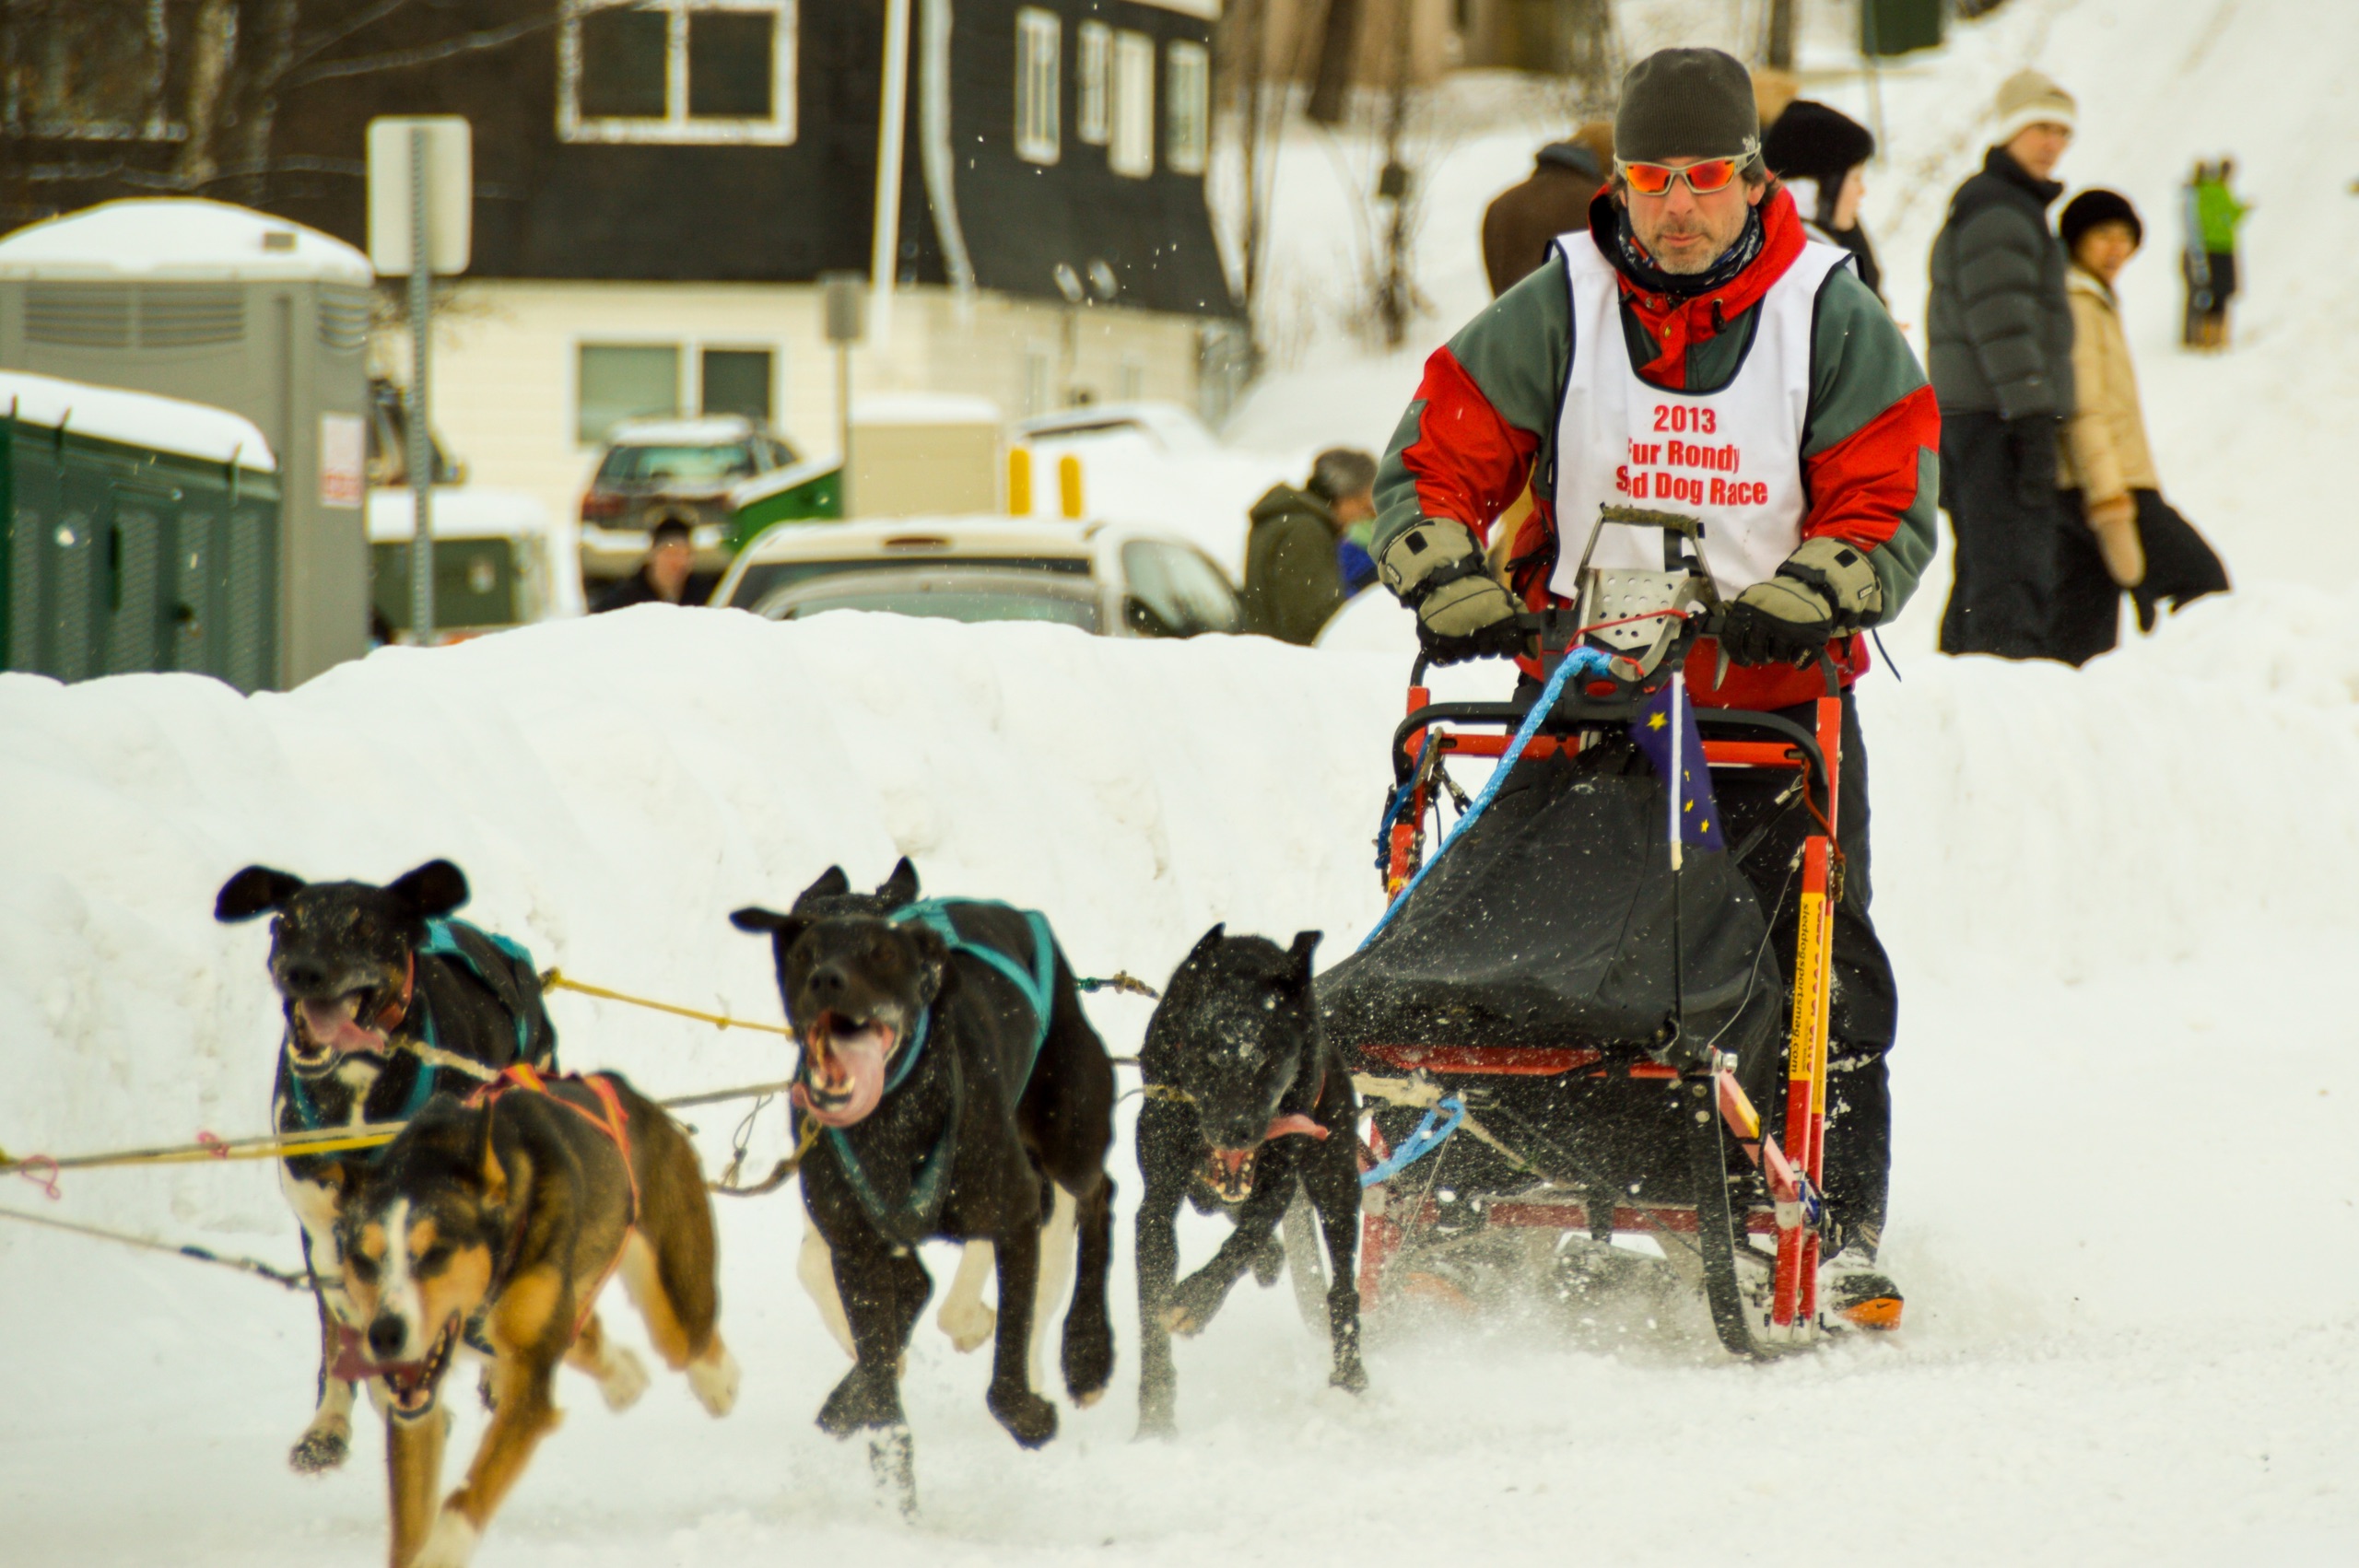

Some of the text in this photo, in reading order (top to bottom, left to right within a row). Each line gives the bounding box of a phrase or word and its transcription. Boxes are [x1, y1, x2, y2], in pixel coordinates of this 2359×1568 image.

[1654, 404, 1716, 435] 2013
[1668, 439, 1740, 474] Rondy
[1656, 472, 1703, 506] Dog
[1709, 477, 1768, 506] Race
[1790, 903, 1810, 1072] sleddogsportsmag.com
